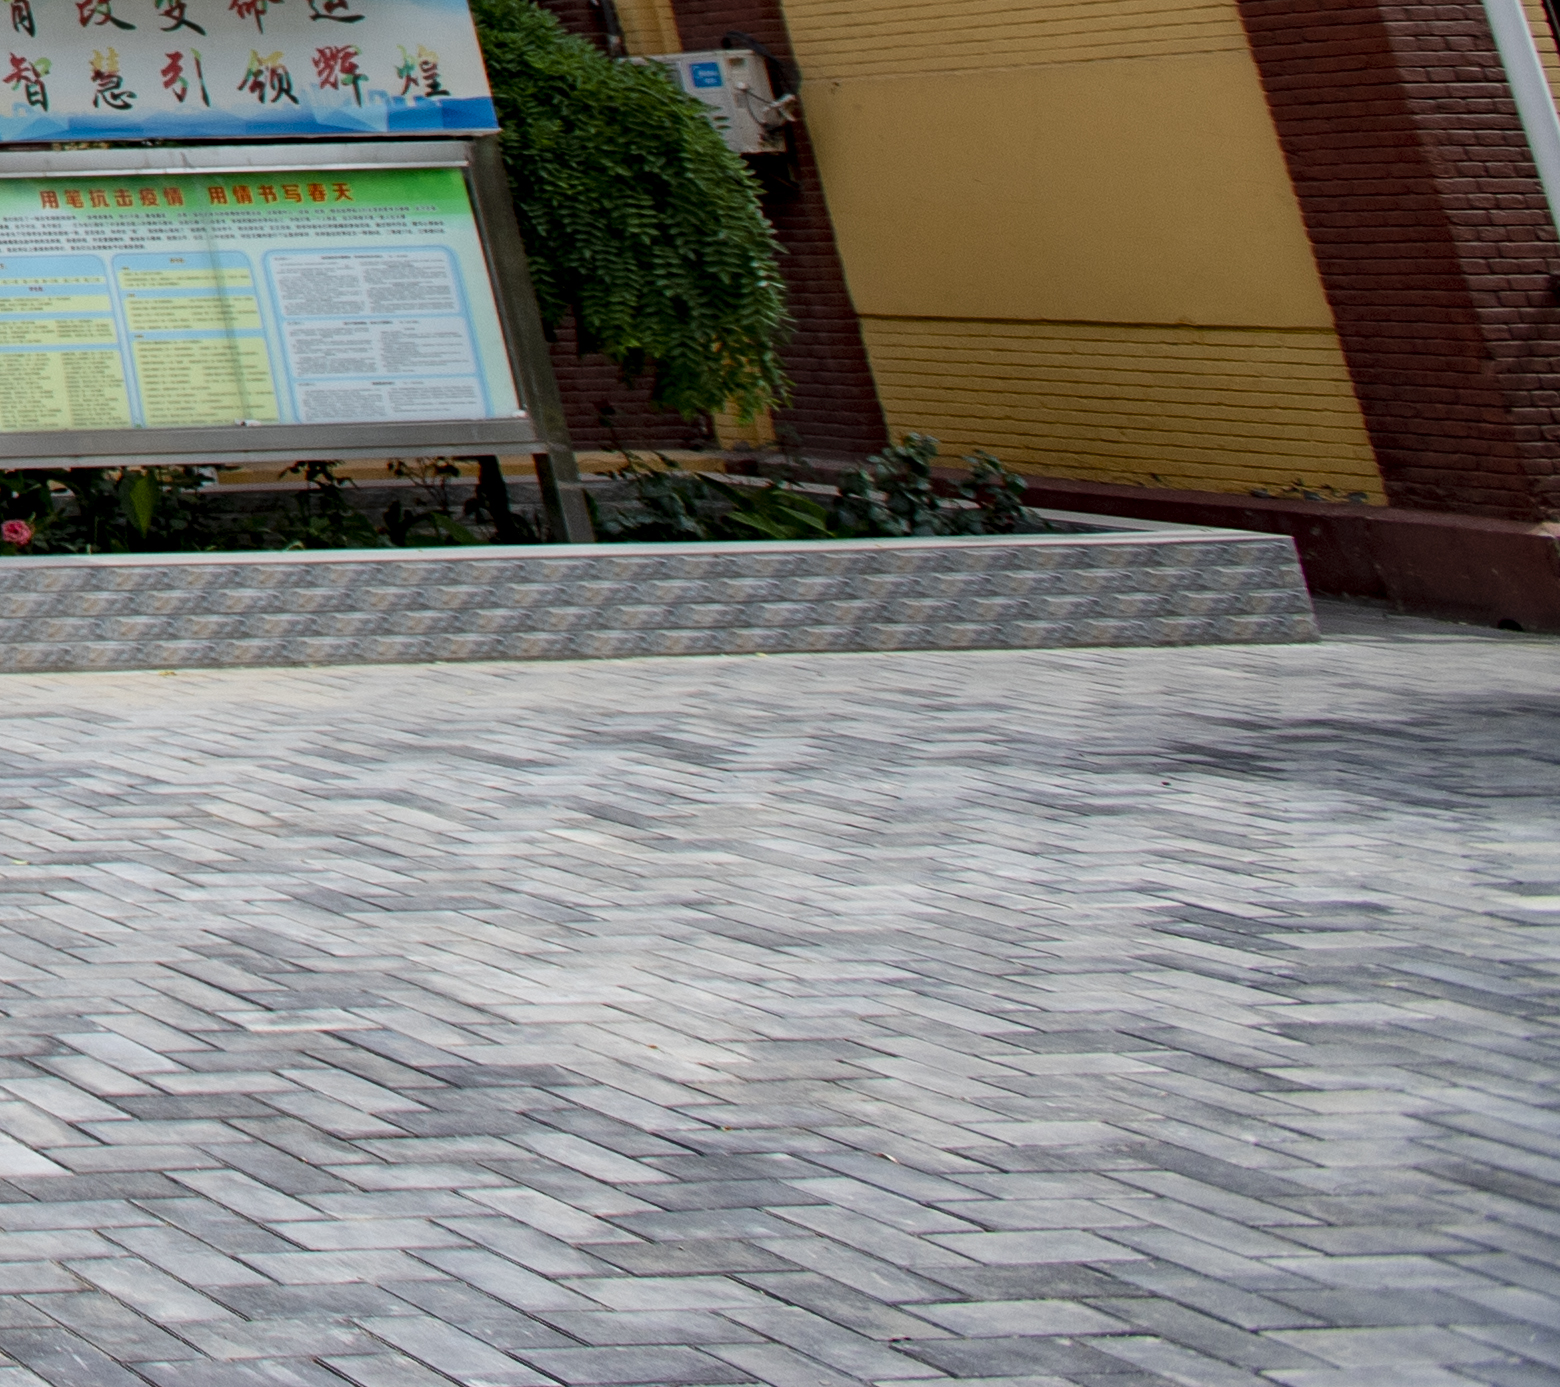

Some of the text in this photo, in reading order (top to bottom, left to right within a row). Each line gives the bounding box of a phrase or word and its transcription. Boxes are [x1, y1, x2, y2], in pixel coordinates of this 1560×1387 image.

[2, 44, 450, 112] 智慧引领辉煌
[39, 182, 353, 209] 用笔抗击疫情 用情书写春天
